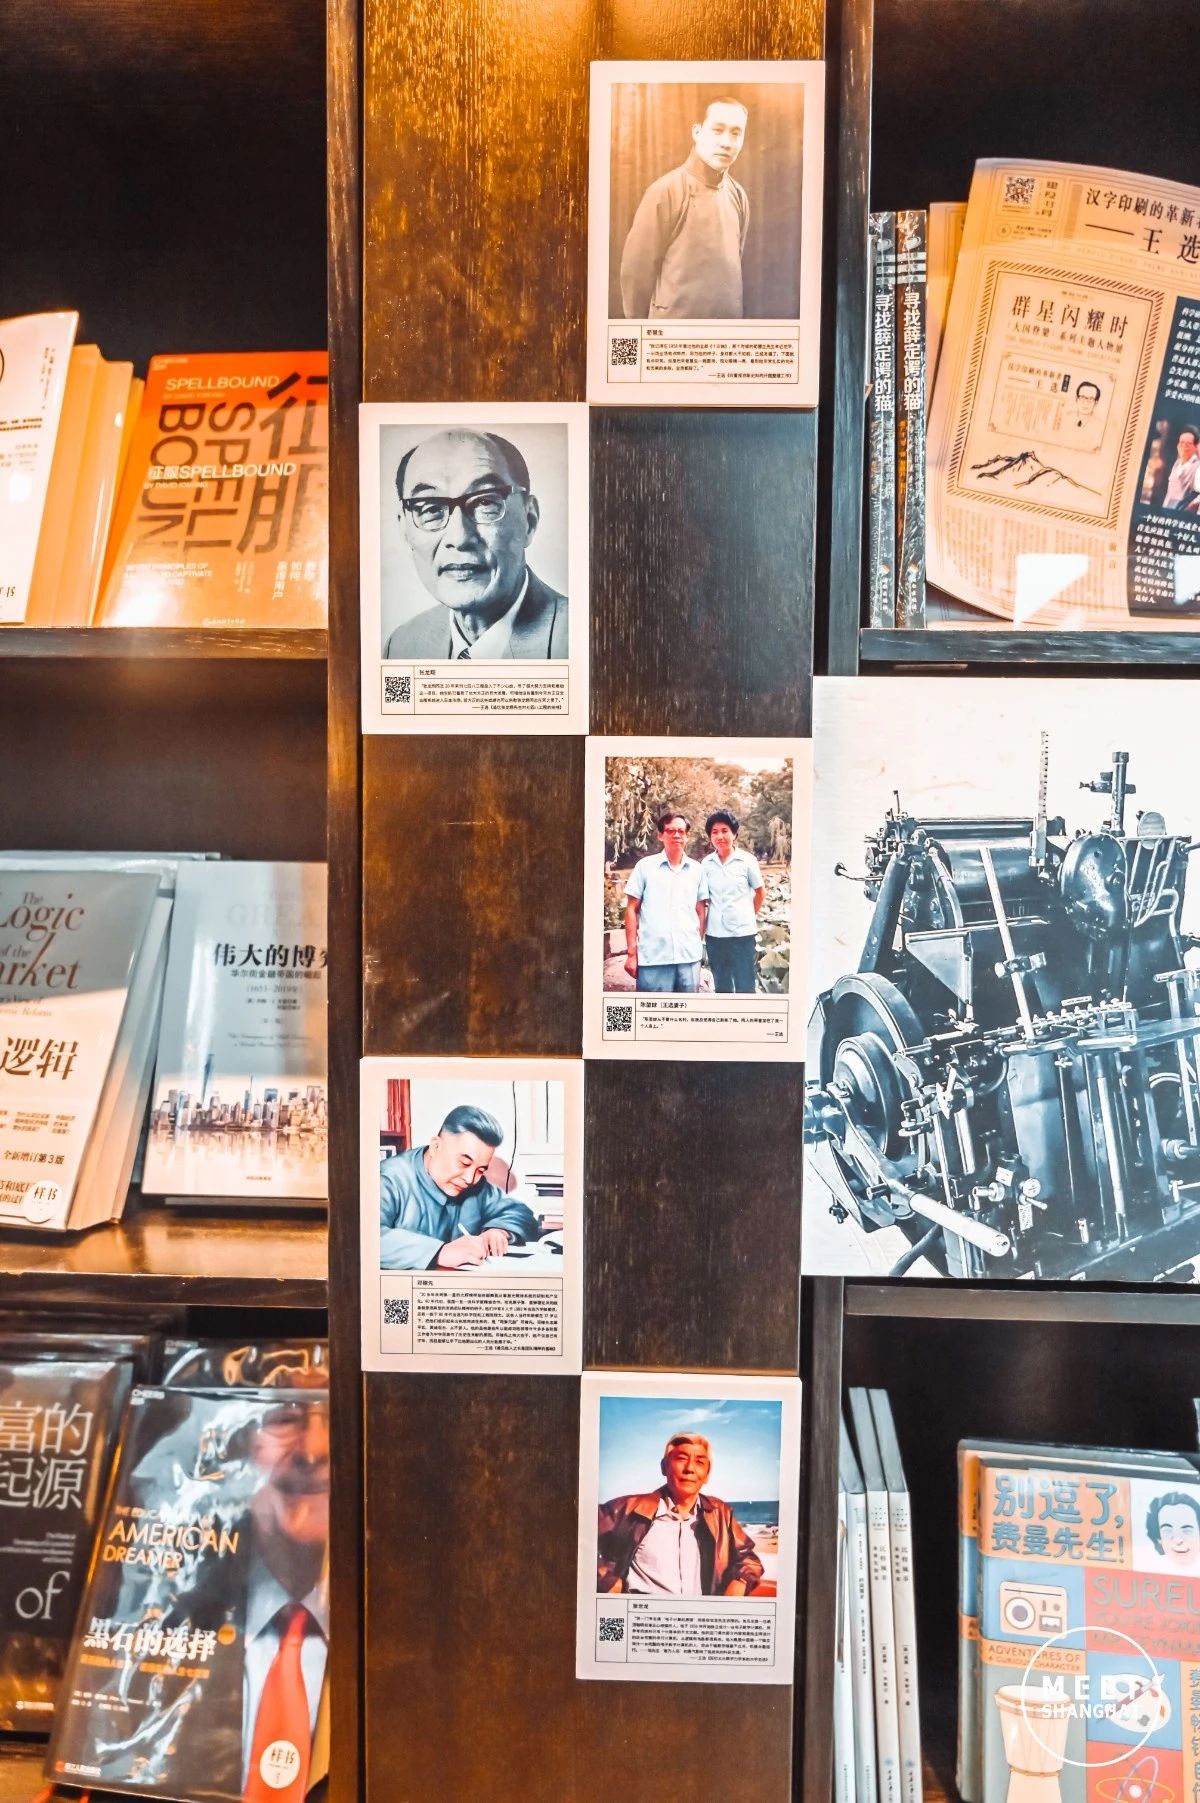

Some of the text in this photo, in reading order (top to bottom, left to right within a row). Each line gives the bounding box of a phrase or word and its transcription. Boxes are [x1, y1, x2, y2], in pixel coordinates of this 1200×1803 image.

[1012, 296, 1128, 339] 群星闪耀时
[875, 294, 892, 411] 寻找薛定谔的猫
[904, 292, 920, 410] 寻找薛定谔的猫
[165, 376, 280, 391] SPELLBOUND
[0, 1037, 79, 1081] 逻辑
[34, 1186, 58, 1201] 样书
[107, 1519, 240, 1554] AMERICAN
[102, 1545, 184, 1569] DREAMER
[16, 1570, 71, 1620] of
[84, 1616, 217, 1662] 黑石的选择
[988, 1645, 1081, 1662] ADVENTURES OF
[271, 1747, 296, 1764] 样书
